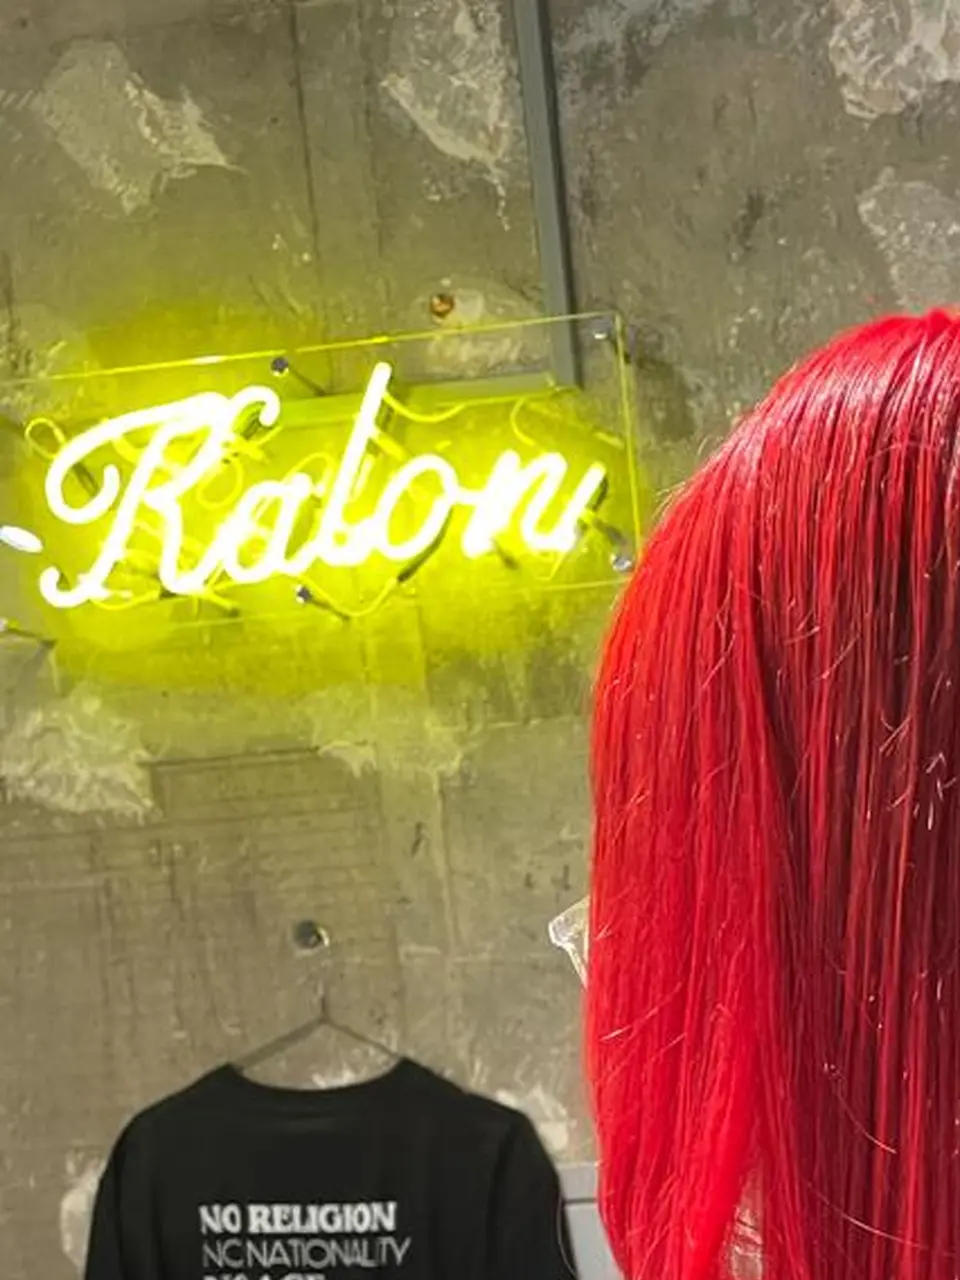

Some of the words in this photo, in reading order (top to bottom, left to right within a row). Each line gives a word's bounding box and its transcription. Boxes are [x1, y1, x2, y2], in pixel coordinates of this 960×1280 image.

[40, 362, 607, 607] Kalon
[199, 1203, 242, 1235] NO
[247, 1201, 397, 1235] RELIGION
